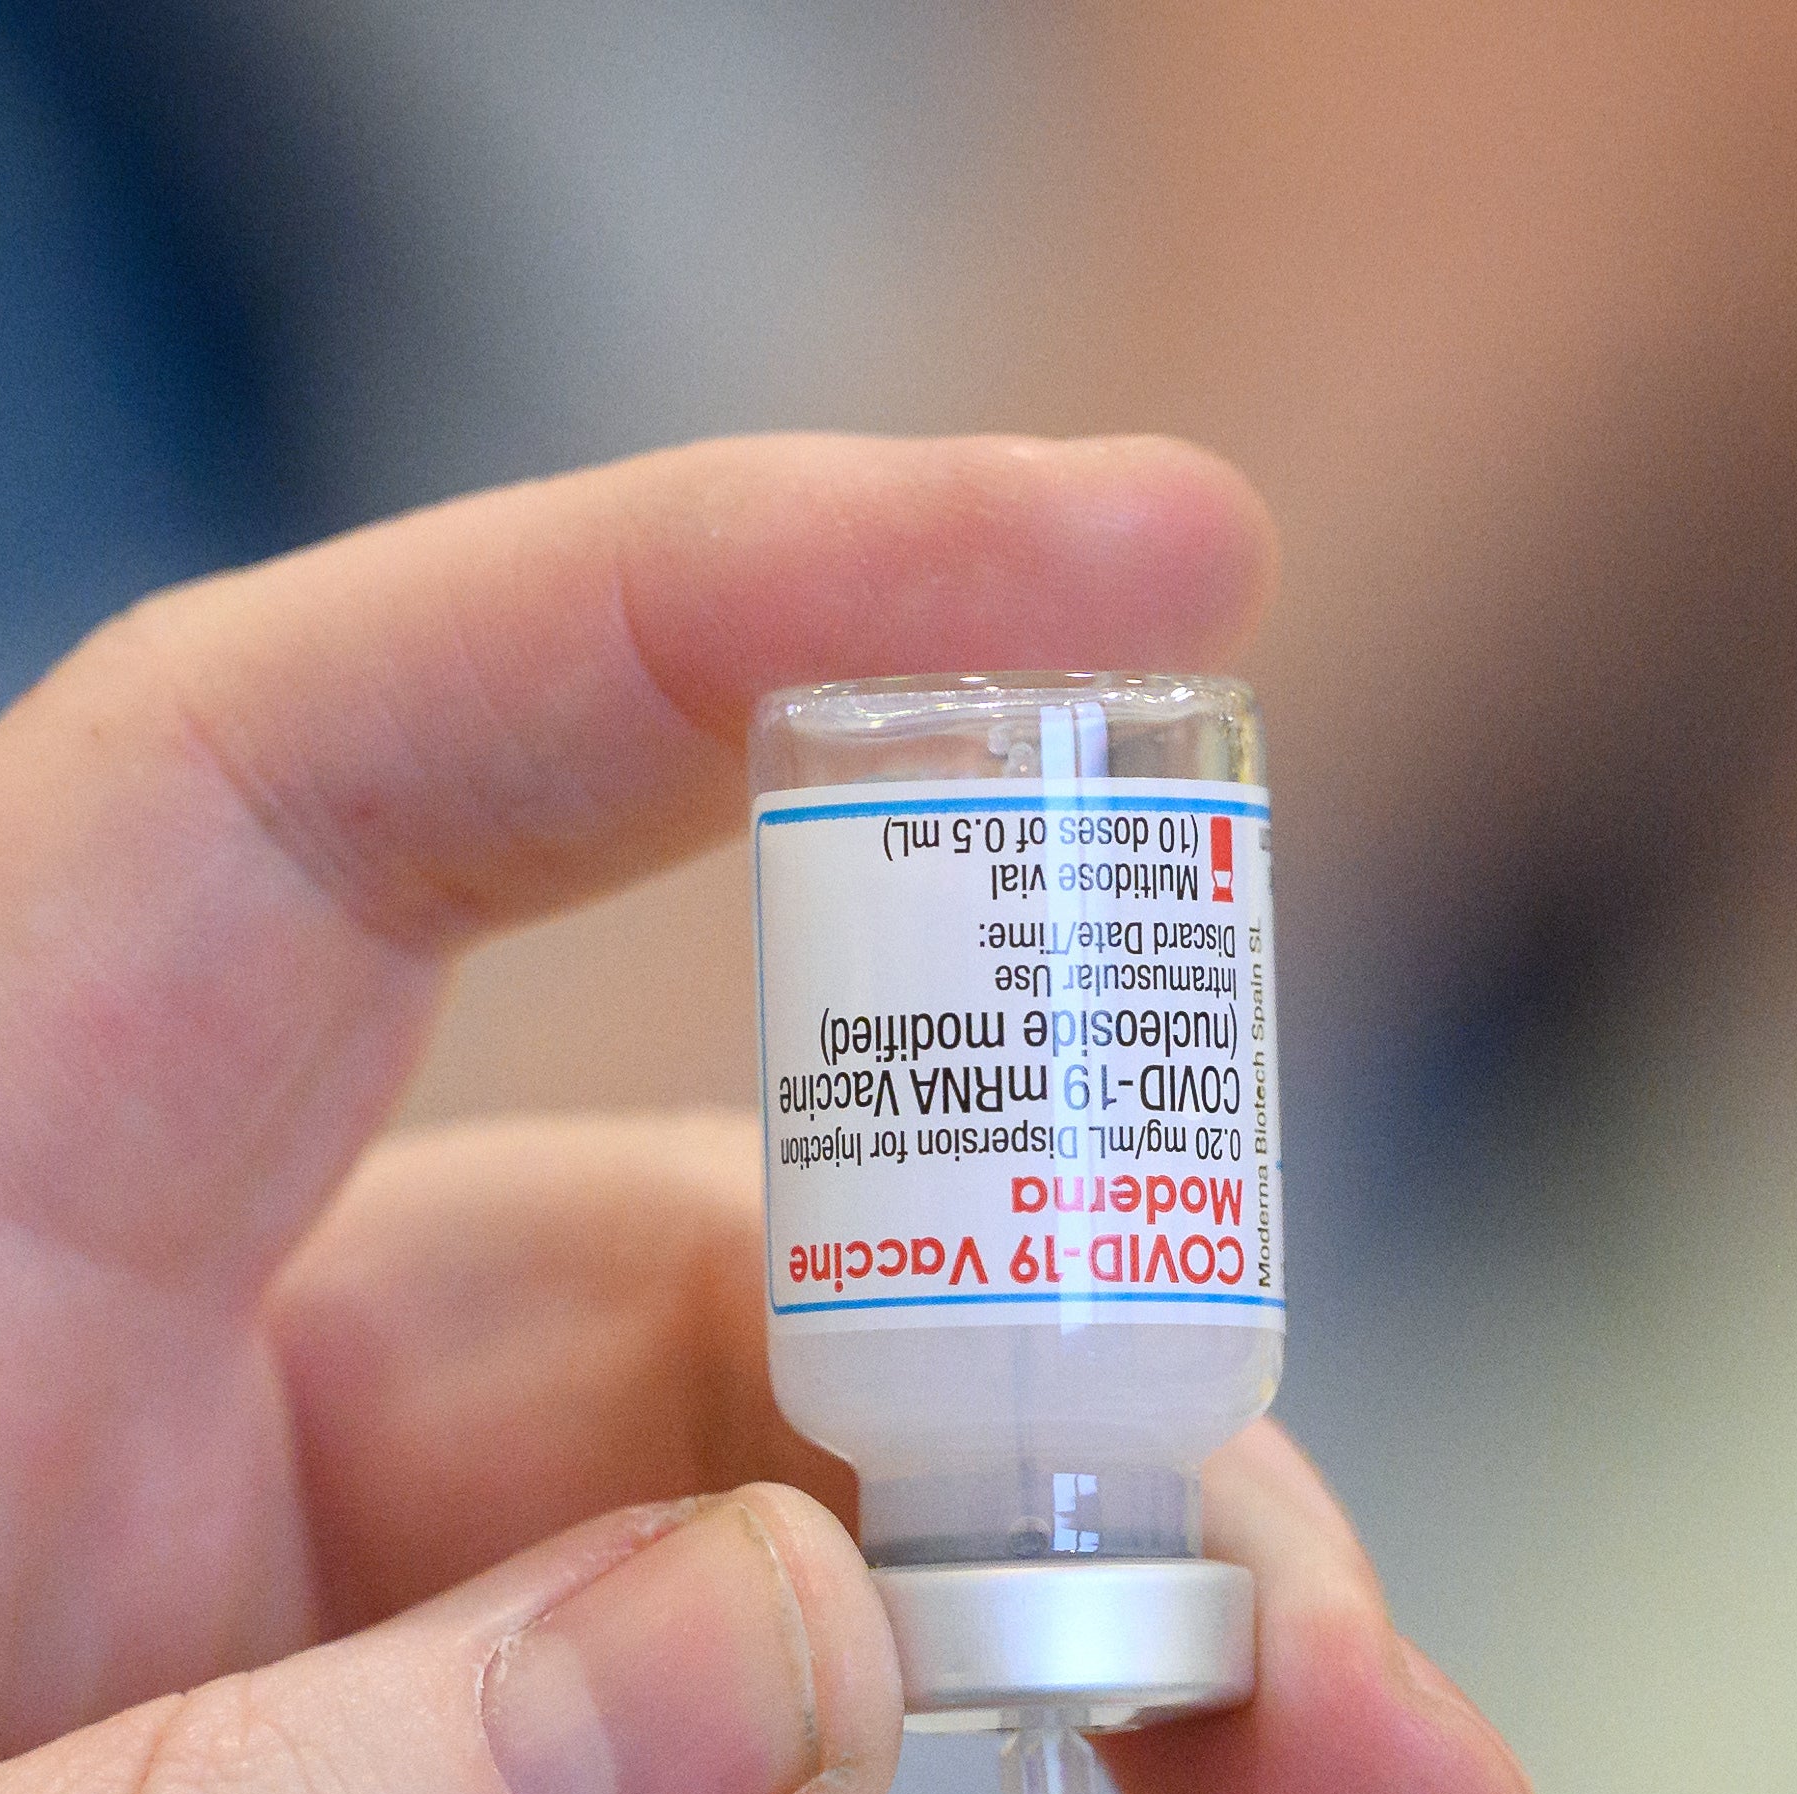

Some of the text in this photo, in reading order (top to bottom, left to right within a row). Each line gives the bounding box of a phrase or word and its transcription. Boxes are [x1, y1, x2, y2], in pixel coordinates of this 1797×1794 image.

[883, 815, 1199, 861] (10 doses of 0.5 mL)
[991, 863, 1198, 899] Multidose vial
[979, 921, 1235, 957] Discard Date/Time:
[995, 964, 1237, 999] Intramuscular Use
[1249, 964, 1265, 1041] Spain
[820, 1003, 1237, 1065] (nucleoside modified)
[779, 1064, 1240, 1120] COVID-19 mRNA Vaccine
[1251, 1052, 1268, 1154] Biotech
[781, 1119, 1241, 1170] 0.20 mg/mL Dispersion for Injection
[1011, 1175, 1242, 1225] Moderna
[1253, 1165, 1271, 1287] Moderna
[789, 1234, 1243, 1292] COVID-19 Vaccine
